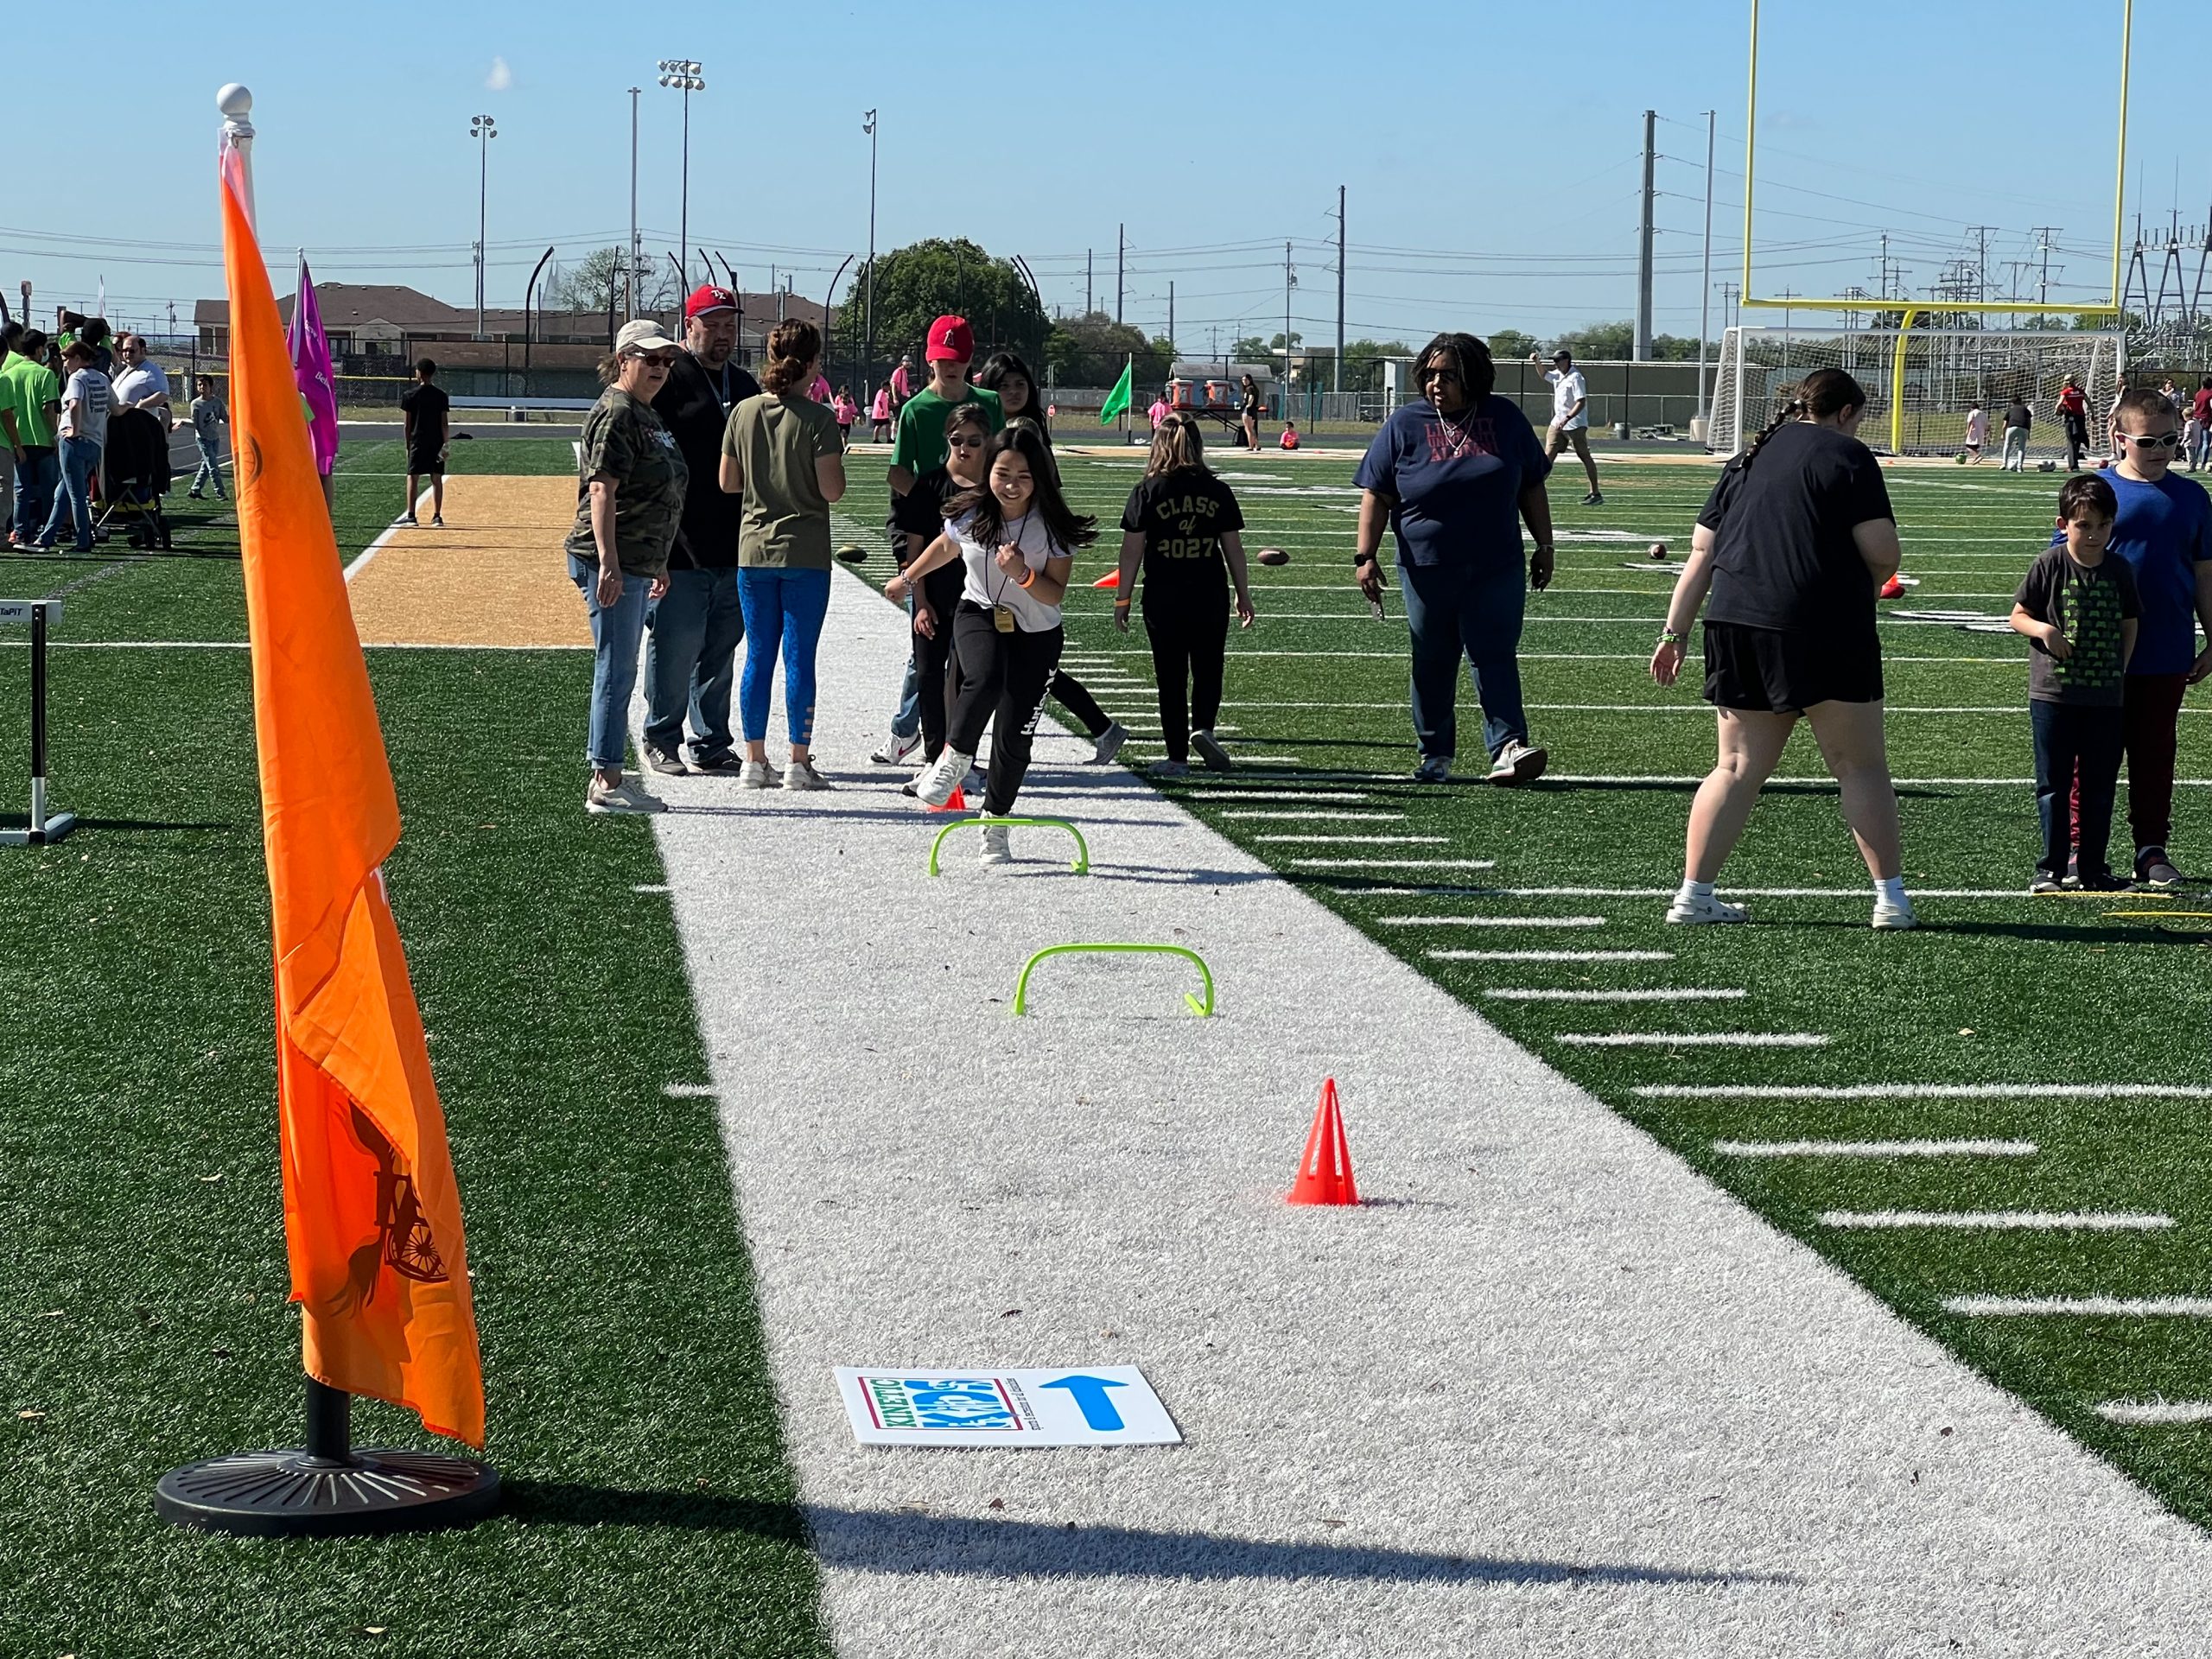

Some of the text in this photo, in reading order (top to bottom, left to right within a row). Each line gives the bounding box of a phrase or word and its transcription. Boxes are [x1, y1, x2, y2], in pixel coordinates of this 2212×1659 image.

[1156, 495, 1219, 519] CLASS
[1179, 515, 1196, 535] of
[1157, 538, 1214, 558] 2027
[870, 1379, 917, 1427] KINETIC
[904, 1380, 1020, 1428] KIDS
